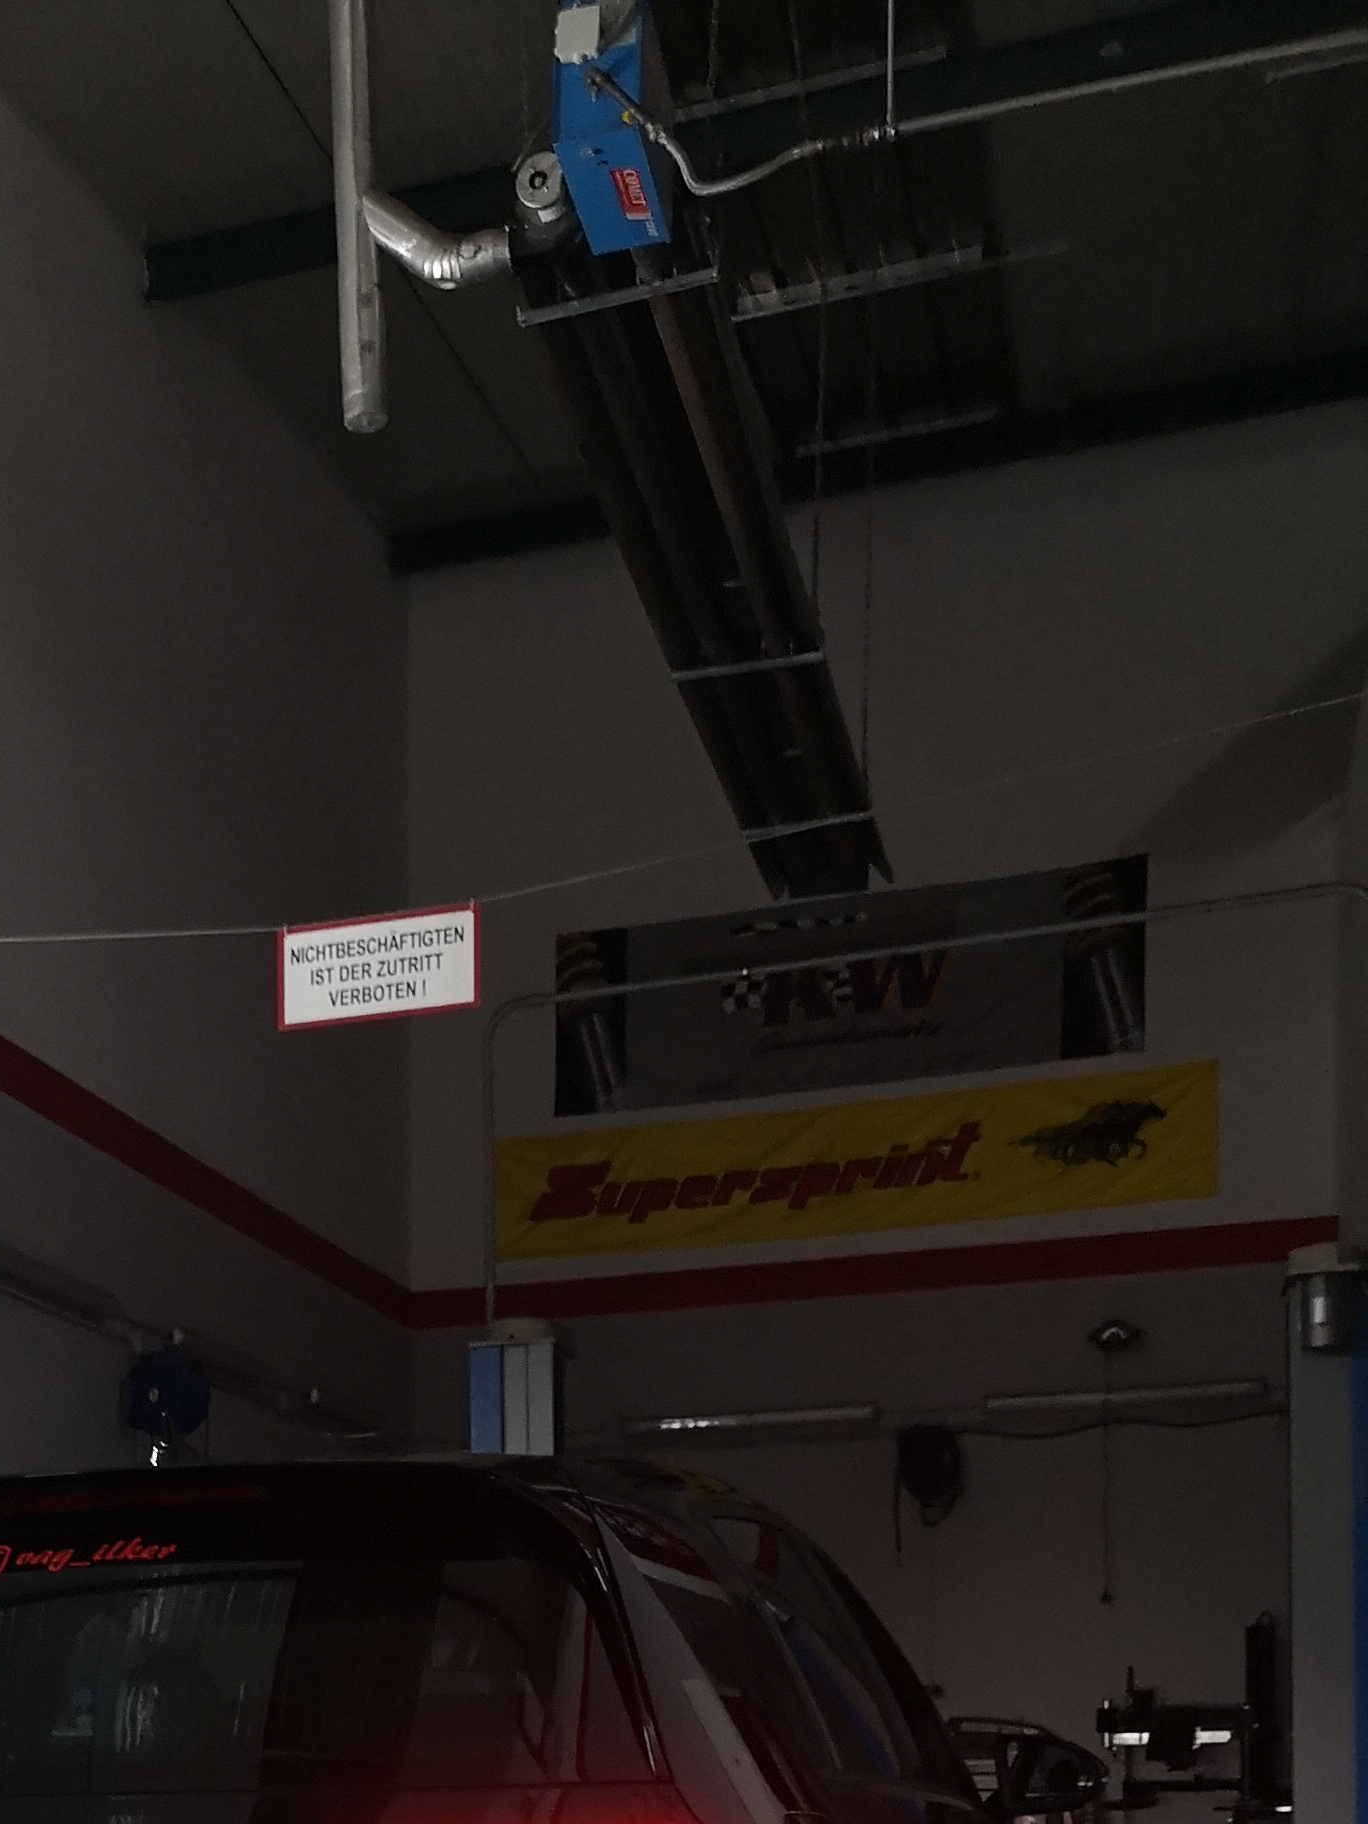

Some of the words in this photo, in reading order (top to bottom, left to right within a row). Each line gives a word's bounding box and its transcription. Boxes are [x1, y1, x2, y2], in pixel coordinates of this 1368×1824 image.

[290, 925, 466, 965] NICHTBESCHÄFTIGTEN
[310, 966, 334, 986] IST
[339, 962, 372, 982] DER
[377, 952, 444, 978] ZUTRITT
[328, 981, 416, 1008] VERBOTEN
[529, 1121, 981, 1225] Supersprint
